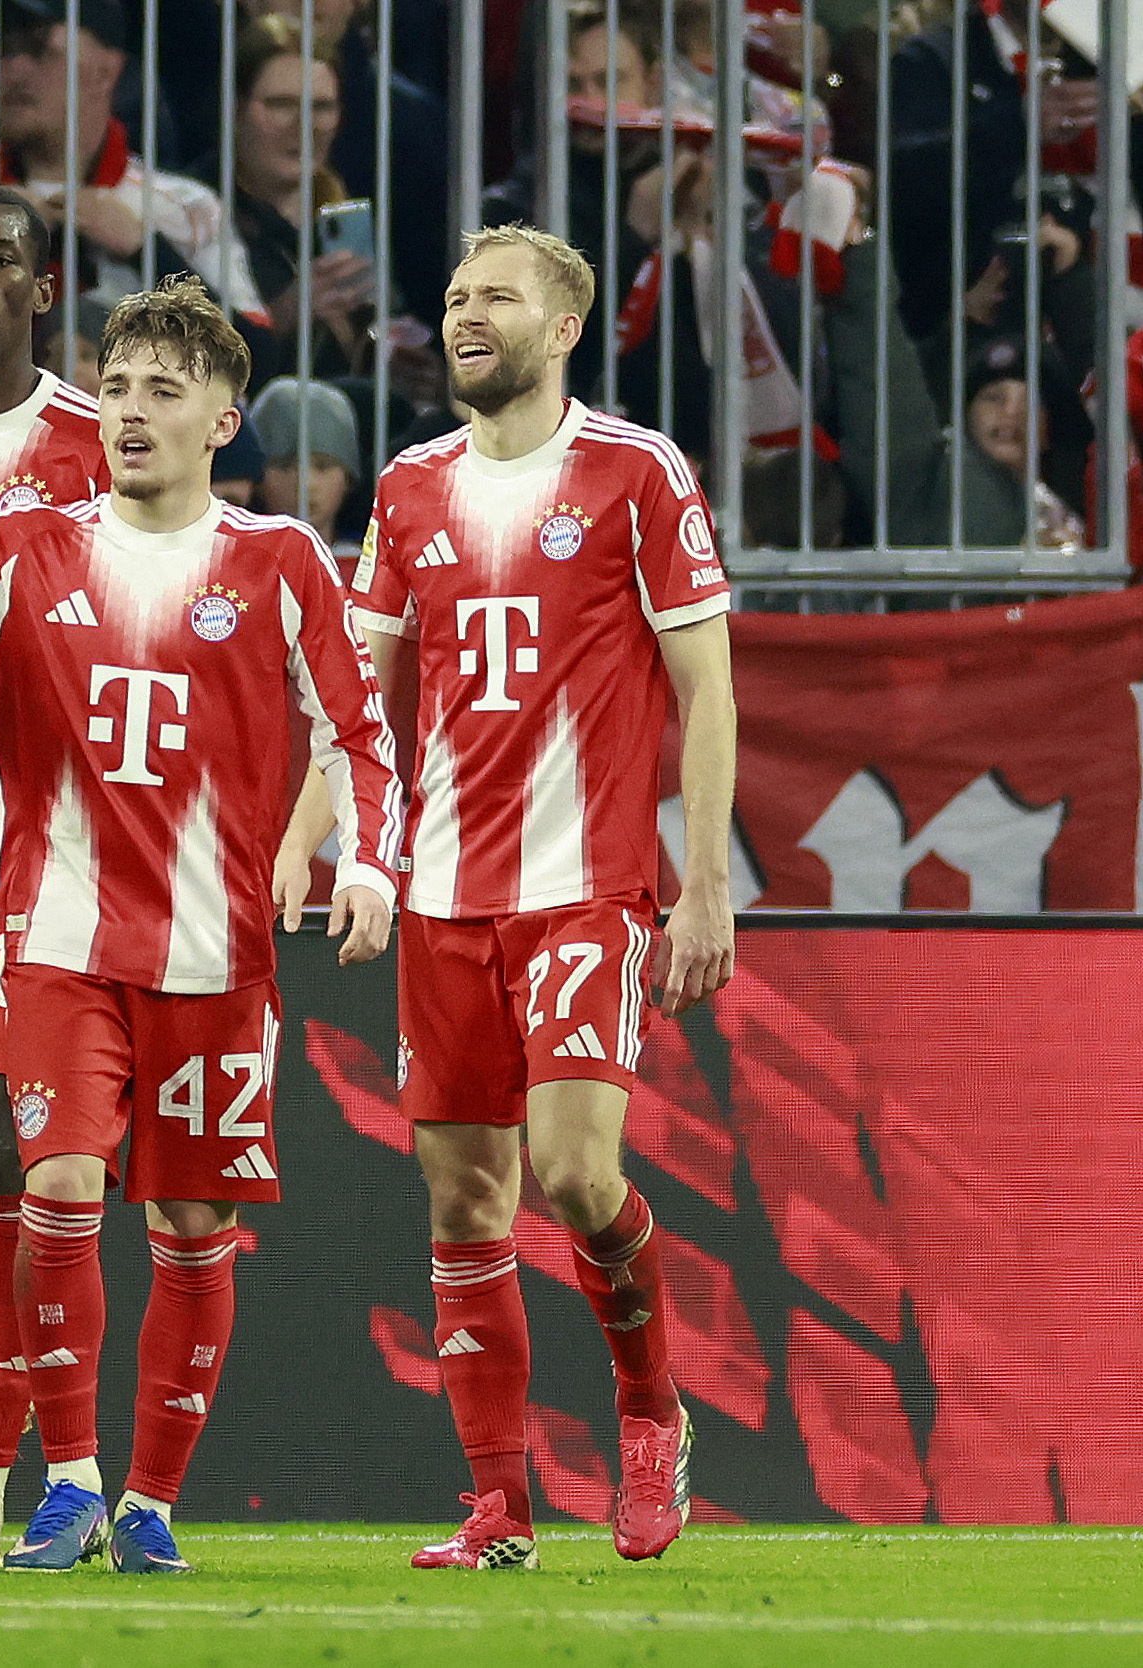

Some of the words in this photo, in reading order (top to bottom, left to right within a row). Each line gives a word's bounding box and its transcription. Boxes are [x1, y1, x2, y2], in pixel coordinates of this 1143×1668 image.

[456, 596, 539, 711] T
[88, 664, 189, 786] T
[526, 942, 604, 1036] 27
[158, 1052, 266, 1137] 42
